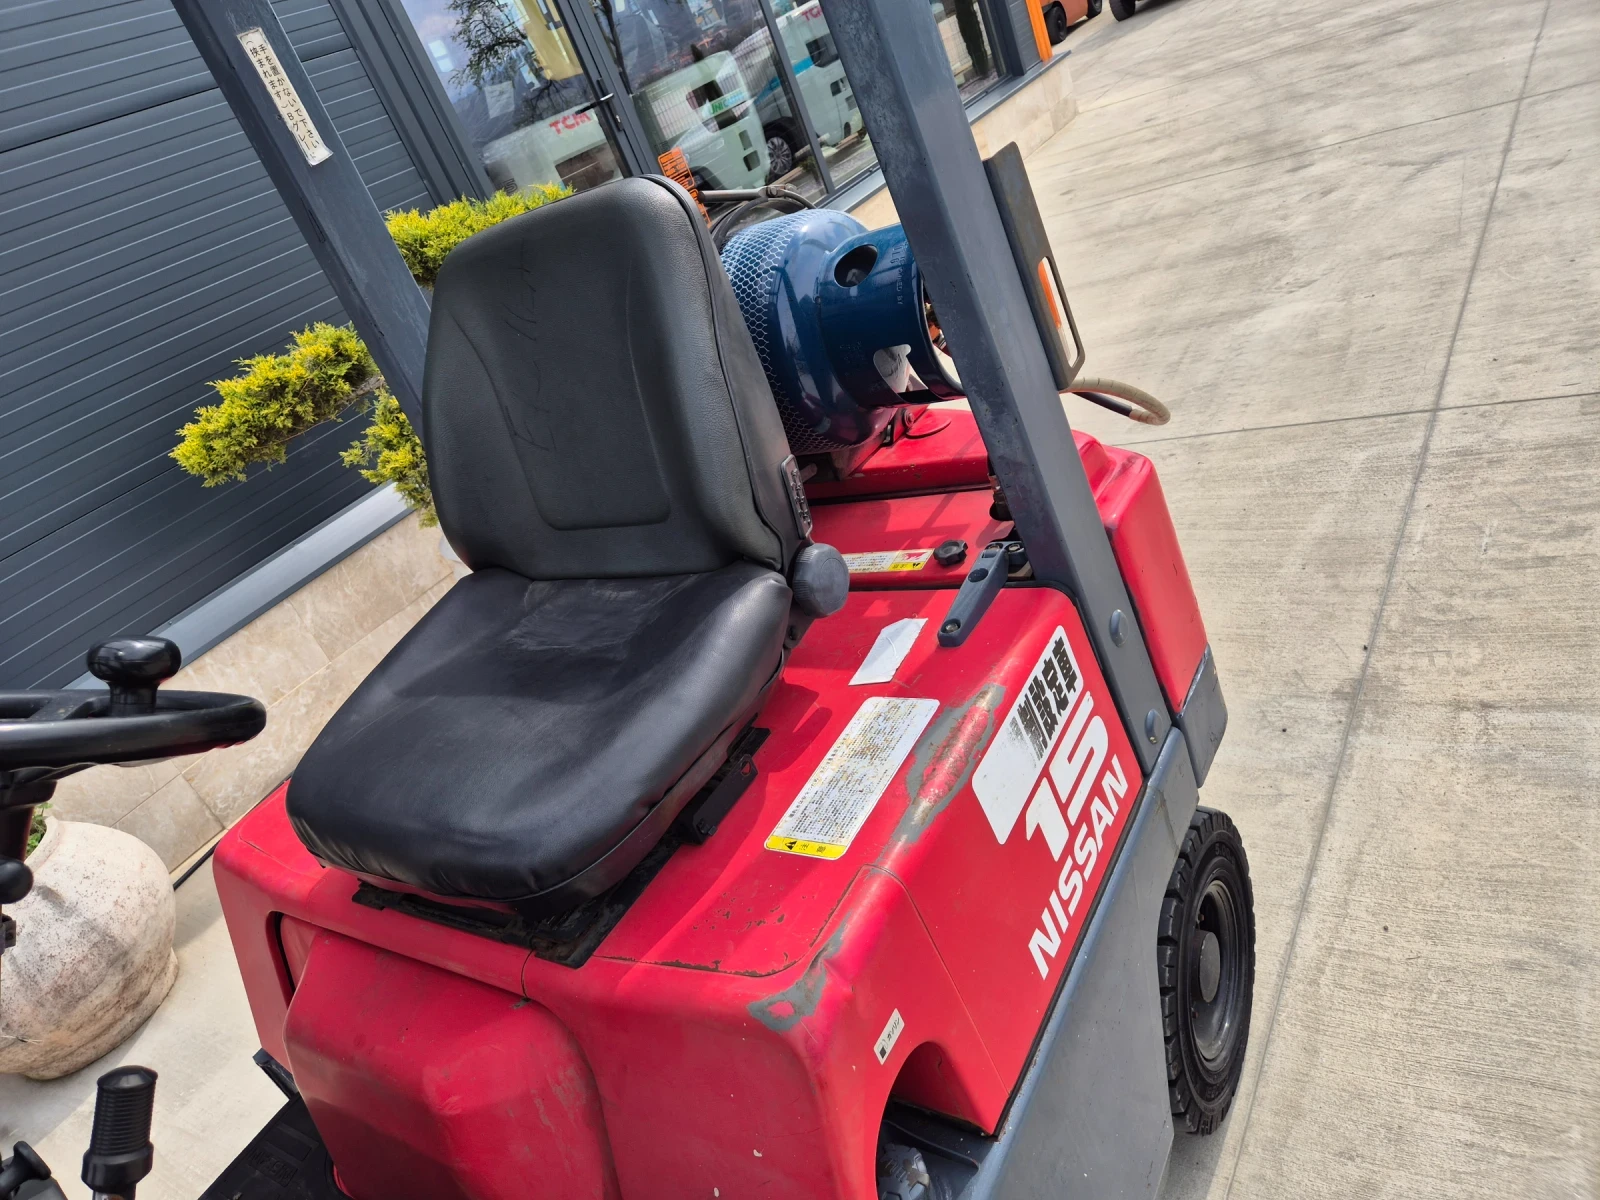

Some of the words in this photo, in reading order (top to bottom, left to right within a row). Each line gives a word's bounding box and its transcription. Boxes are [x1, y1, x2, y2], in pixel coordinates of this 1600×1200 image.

[258, 44, 320, 149] 手を置かないで下さい
[548, 112, 592, 135] TCM
[1025, 690, 1108, 862] 15
[1028, 754, 1128, 980] NISSAN
